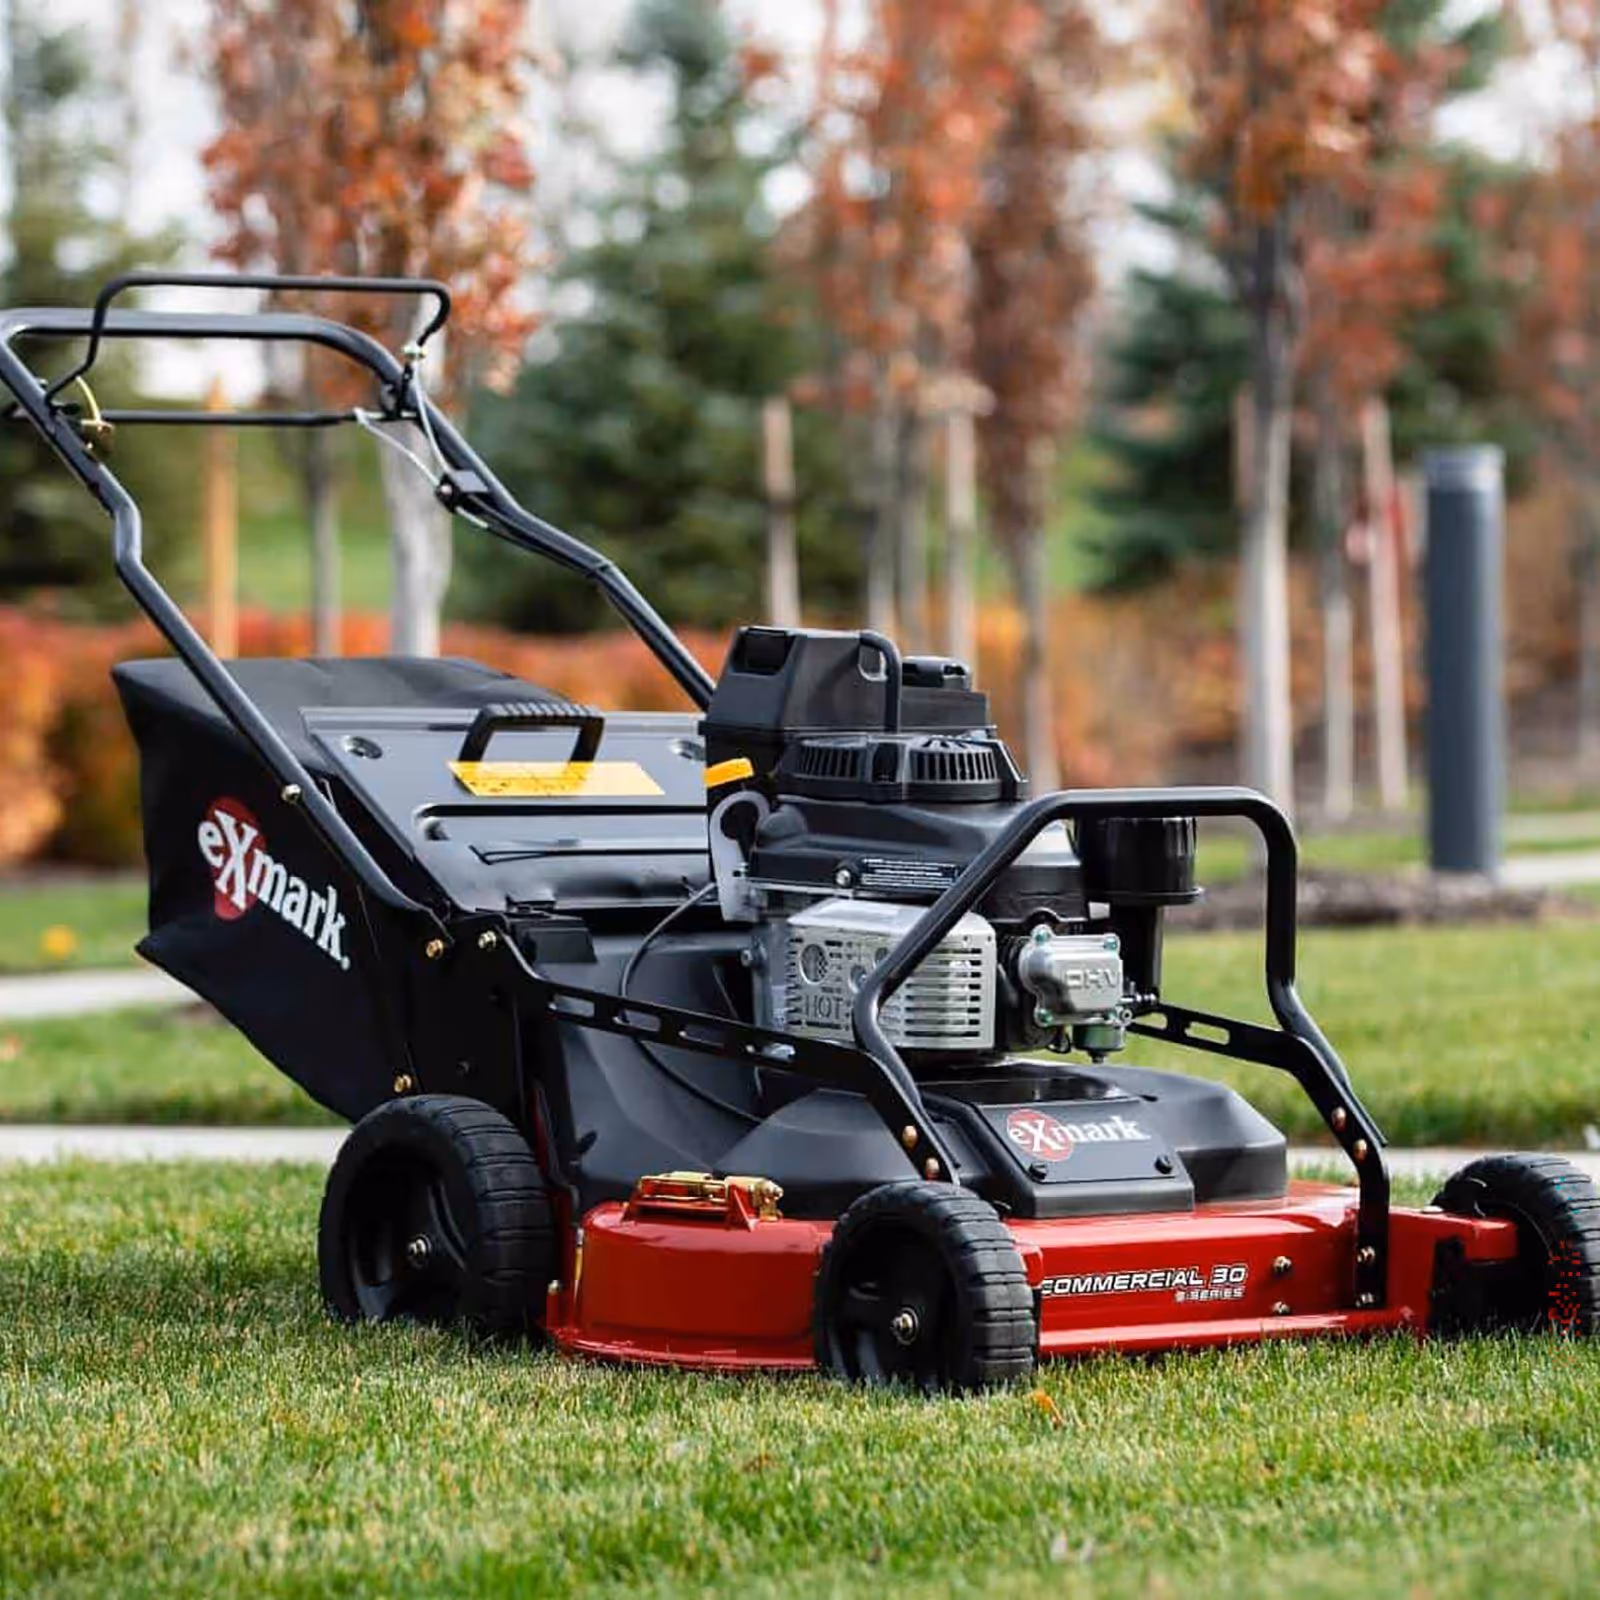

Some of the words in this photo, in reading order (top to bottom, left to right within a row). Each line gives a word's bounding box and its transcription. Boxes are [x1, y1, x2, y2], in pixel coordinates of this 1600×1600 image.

[804, 994, 844, 1020] HOT
[1041, 1267, 1205, 1296] COMMERCIAL
[1210, 1265, 1247, 1285] 30
